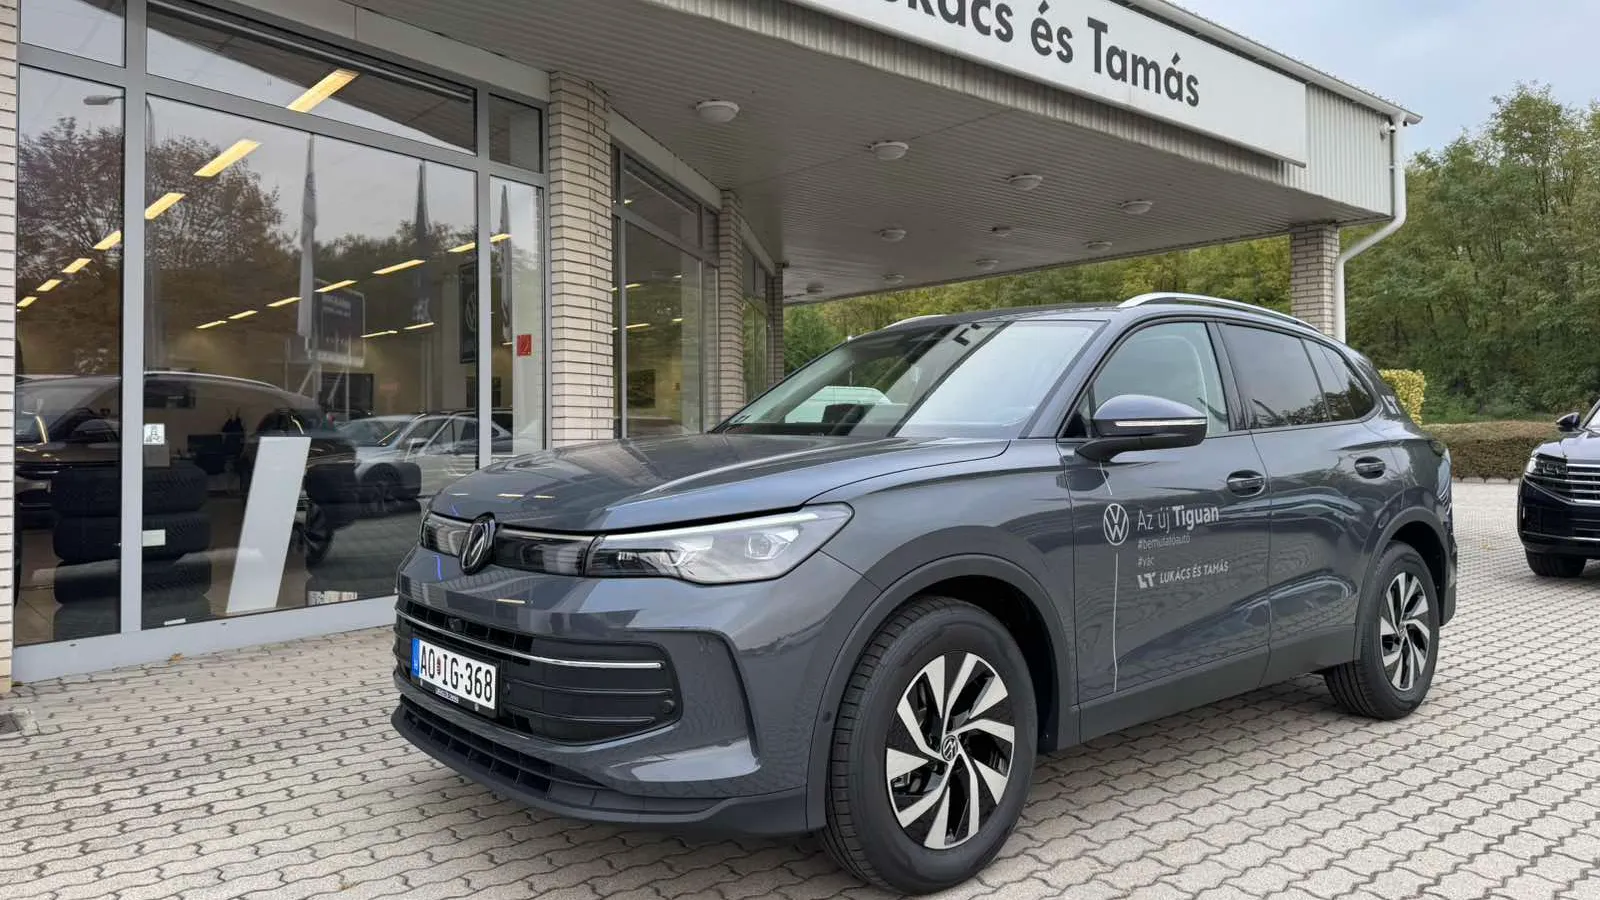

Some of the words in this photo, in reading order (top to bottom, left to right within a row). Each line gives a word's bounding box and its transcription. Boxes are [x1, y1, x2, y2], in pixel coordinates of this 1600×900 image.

[1030, 0, 1073, 64] és
[1087, 17, 1200, 108] Tamás
[1137, 509, 1154, 531] Az
[1158, 507, 1170, 533] új
[1172, 505, 1220, 531] Tiguan
[1160, 566, 1191, 584] LUKÁCS
[1193, 564, 1202, 578] ÉS
[1204, 559, 1230, 576] TAMÁS
